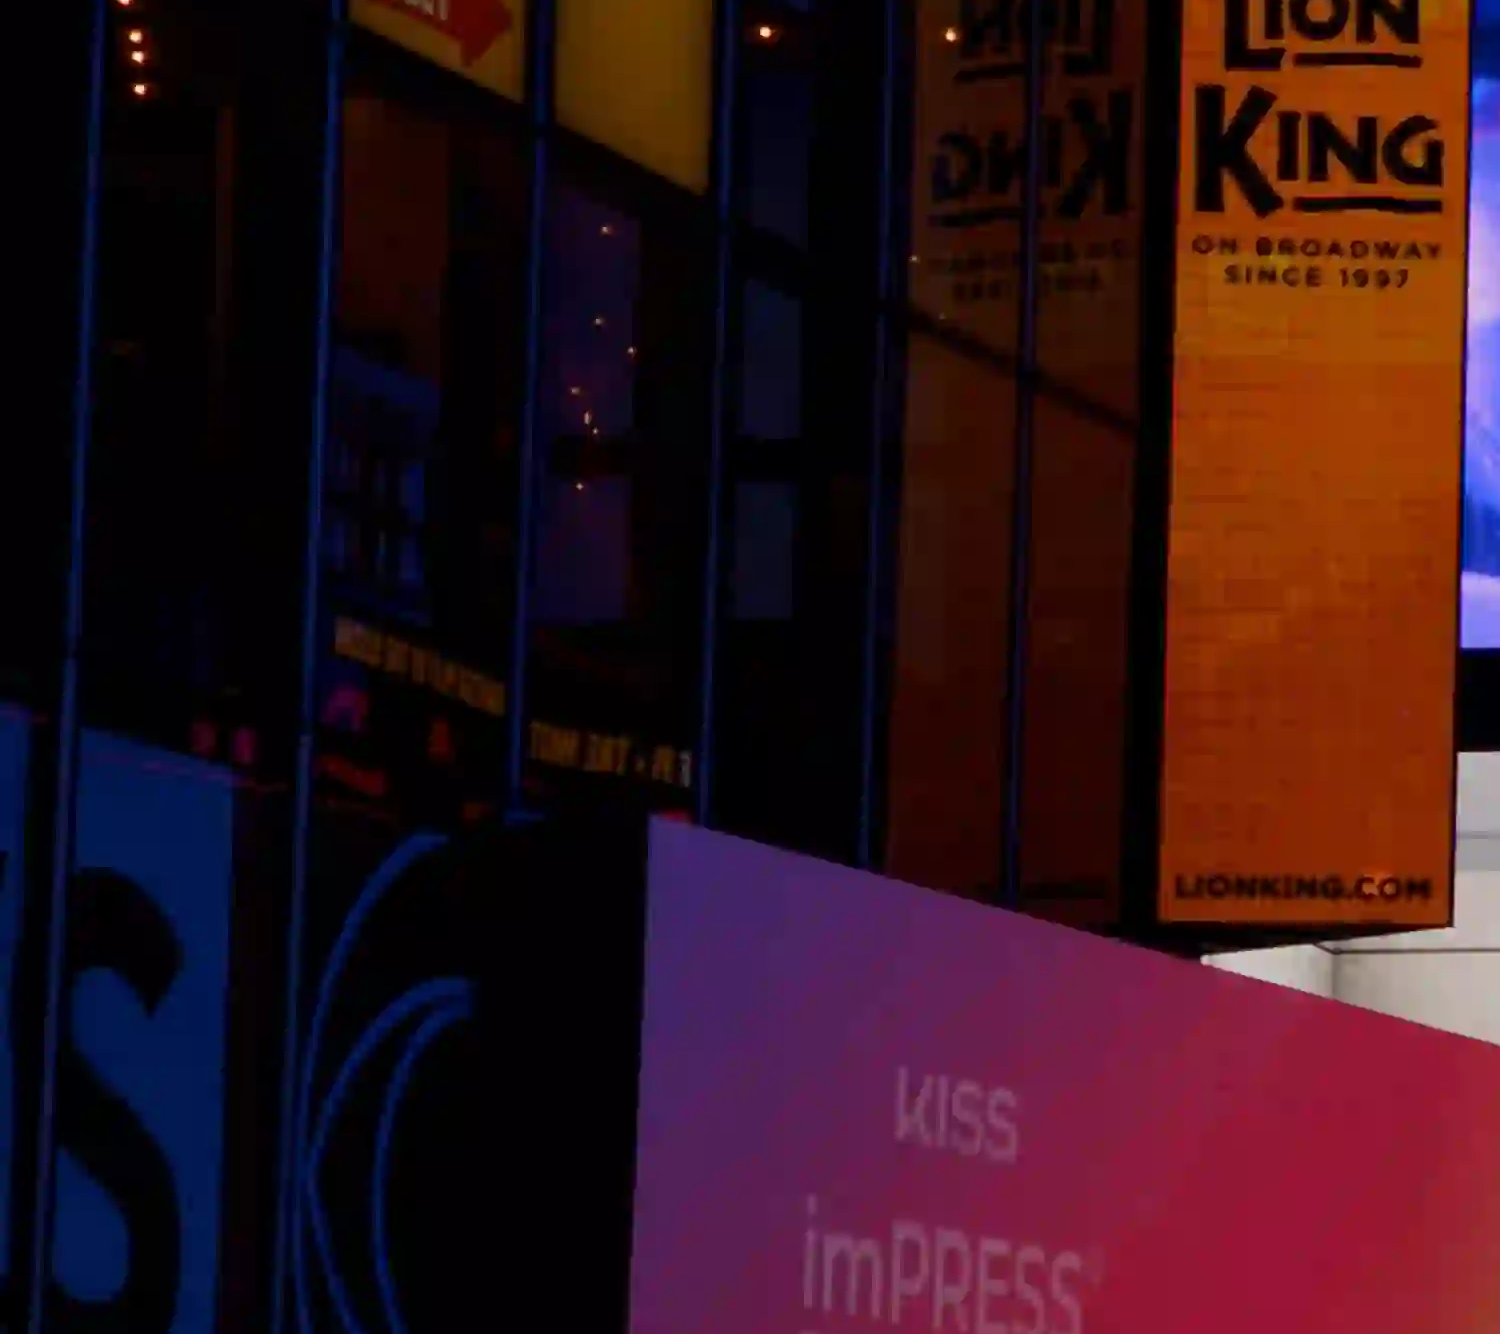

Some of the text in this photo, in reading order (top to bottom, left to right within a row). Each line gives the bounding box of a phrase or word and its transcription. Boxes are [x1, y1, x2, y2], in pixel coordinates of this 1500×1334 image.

[1195, 85, 1442, 217] KING
[1190, 235, 1443, 261] ON BROADWAY
[1223, 265, 1322, 288] SINCE
[1174, 876, 1433, 904] LIONKING.COM
